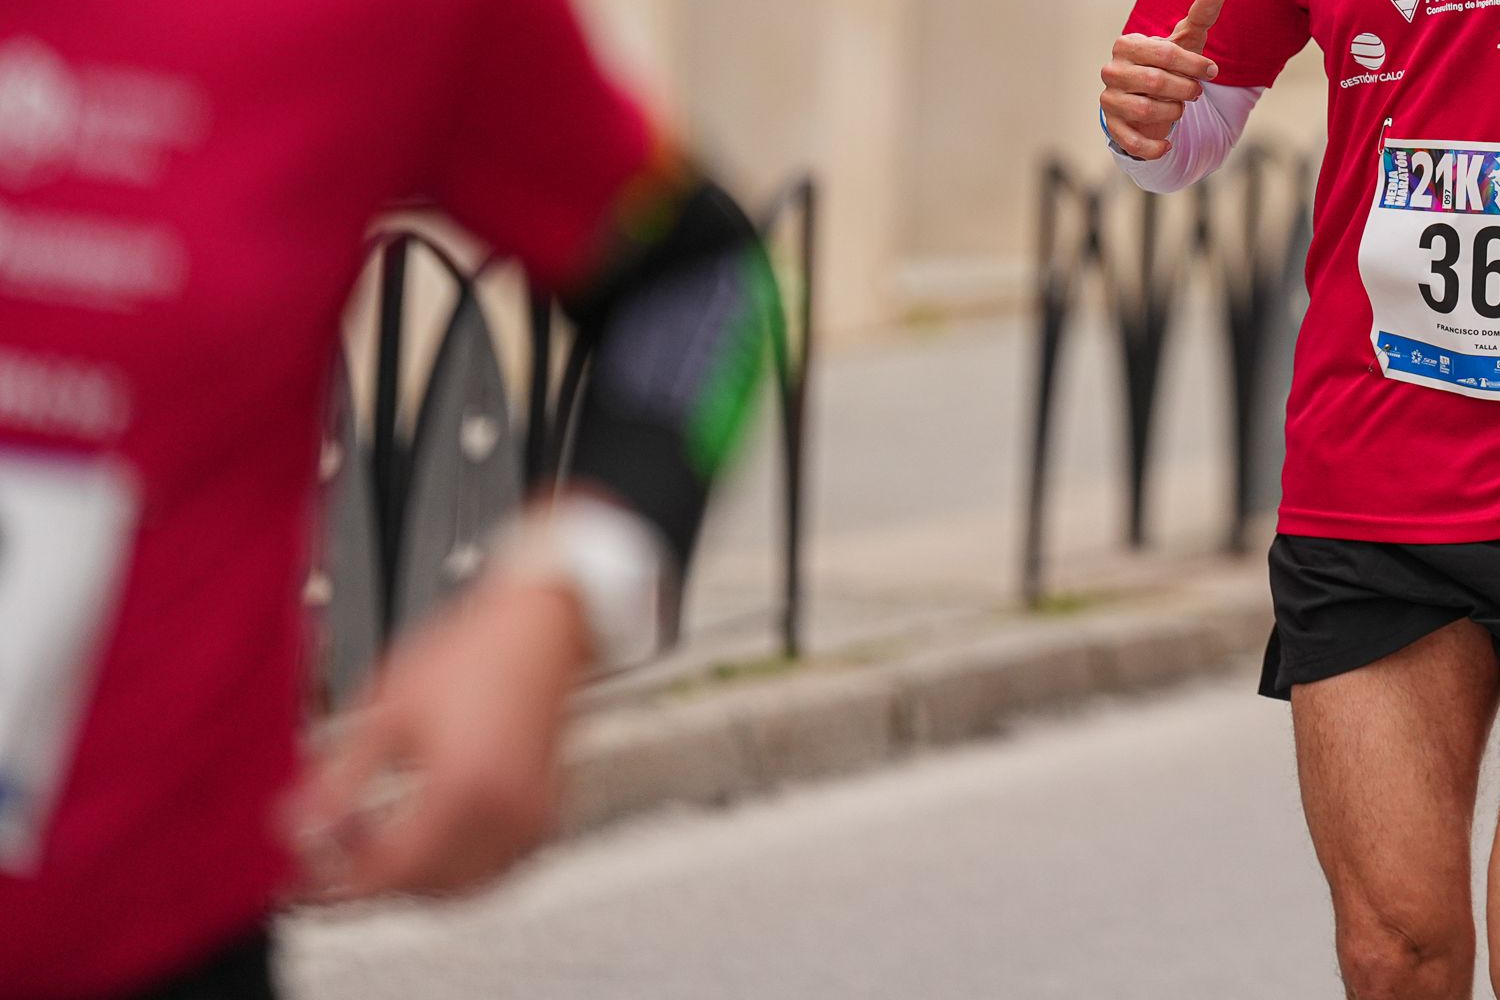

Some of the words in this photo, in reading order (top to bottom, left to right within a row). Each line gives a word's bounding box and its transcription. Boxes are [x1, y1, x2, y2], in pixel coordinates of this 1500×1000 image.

[1426, 3, 1463, 15] Consulting
[1465, 1, 1475, 9] de
[1384, 171, 1398, 205] MEDIA
[1395, 151, 1409, 206] MARATÓN
[1410, 151, 1484, 210] 21K
[1437, 323, 1479, 336] FRANCISCO
